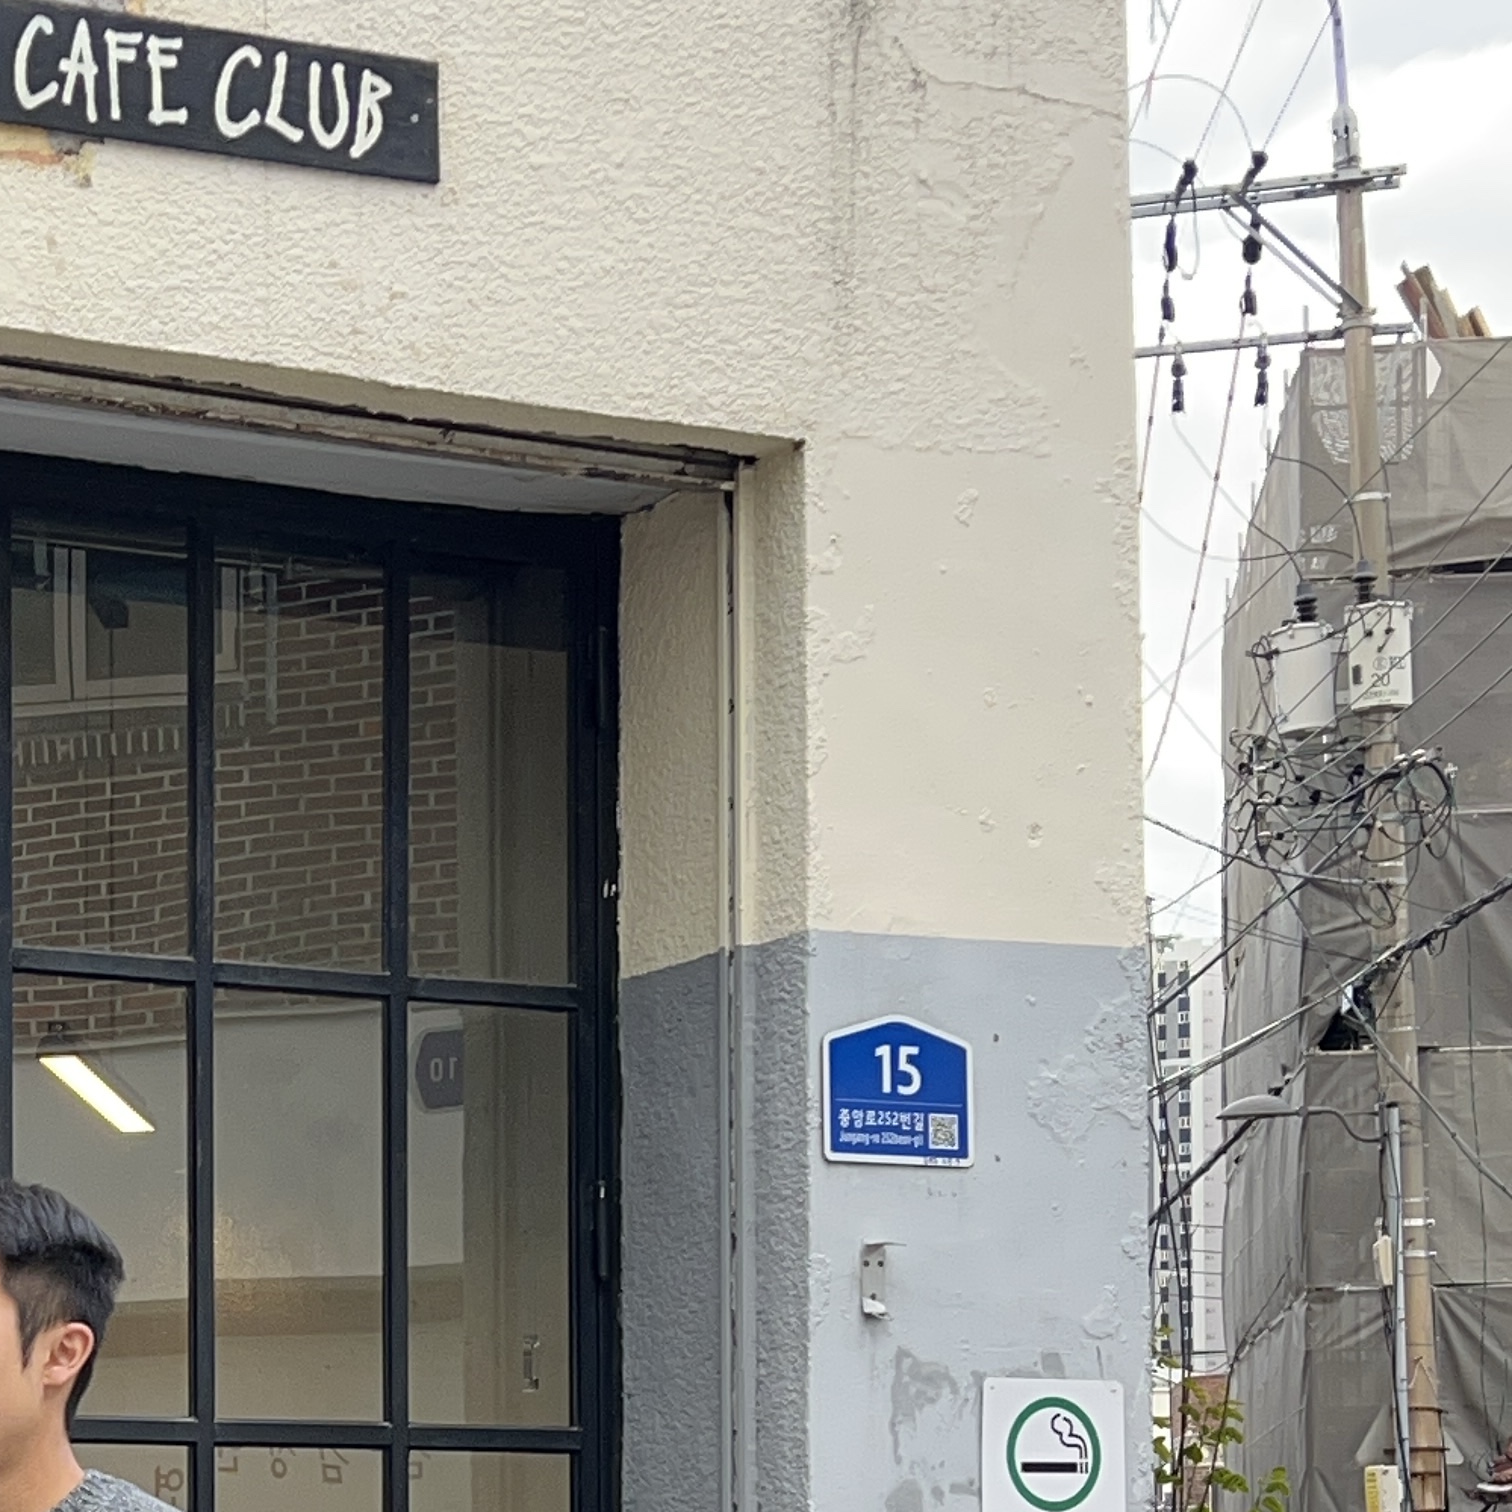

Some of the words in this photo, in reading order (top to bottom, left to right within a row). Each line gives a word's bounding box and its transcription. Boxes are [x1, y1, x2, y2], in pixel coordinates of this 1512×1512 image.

[14, 14, 188, 125] CAFE
[214, 45, 392, 159] CLUB
[874, 1044, 922, 1096] 15
